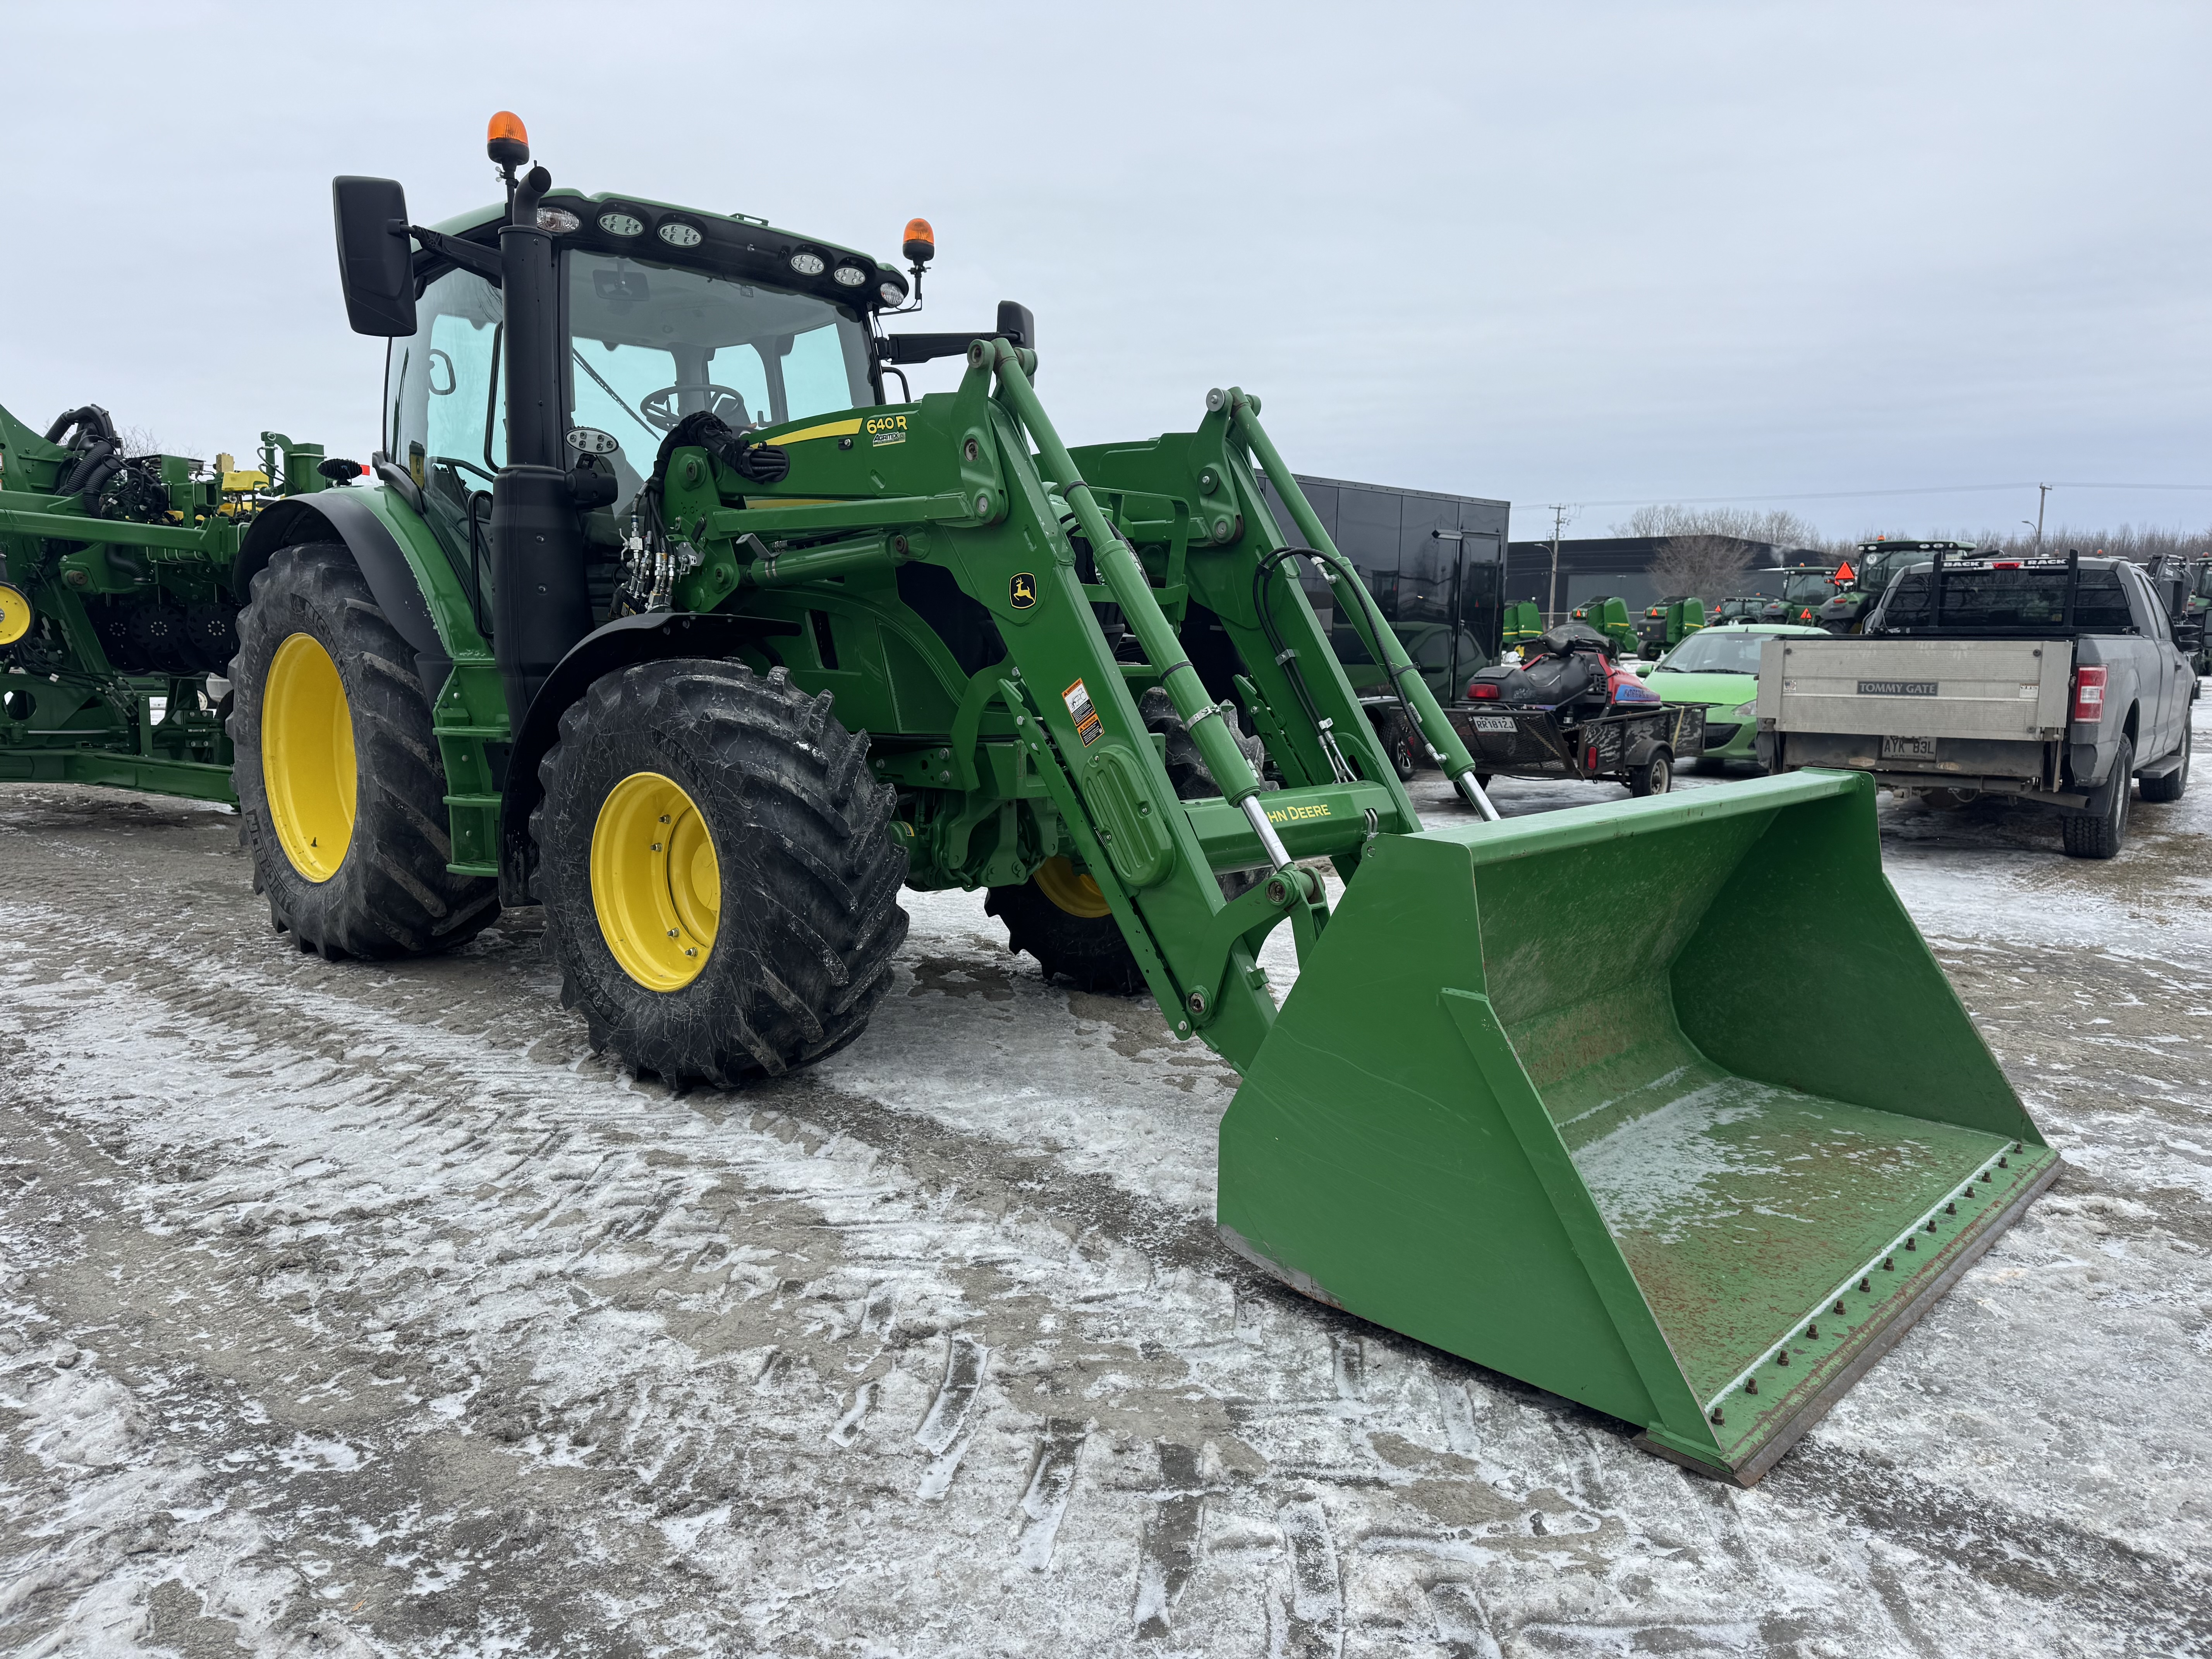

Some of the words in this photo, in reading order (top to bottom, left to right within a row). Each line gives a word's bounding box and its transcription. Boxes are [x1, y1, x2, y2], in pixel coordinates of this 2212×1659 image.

[1860, 683, 1903, 693] TOMMY
[1905, 684, 1936, 694] GATE
[1476, 720, 1514, 728] RR1812J
[1266, 810, 1288, 823] HN
[1286, 804, 1331, 820] DEERE
[246, 814, 287, 905] MICHELIN
